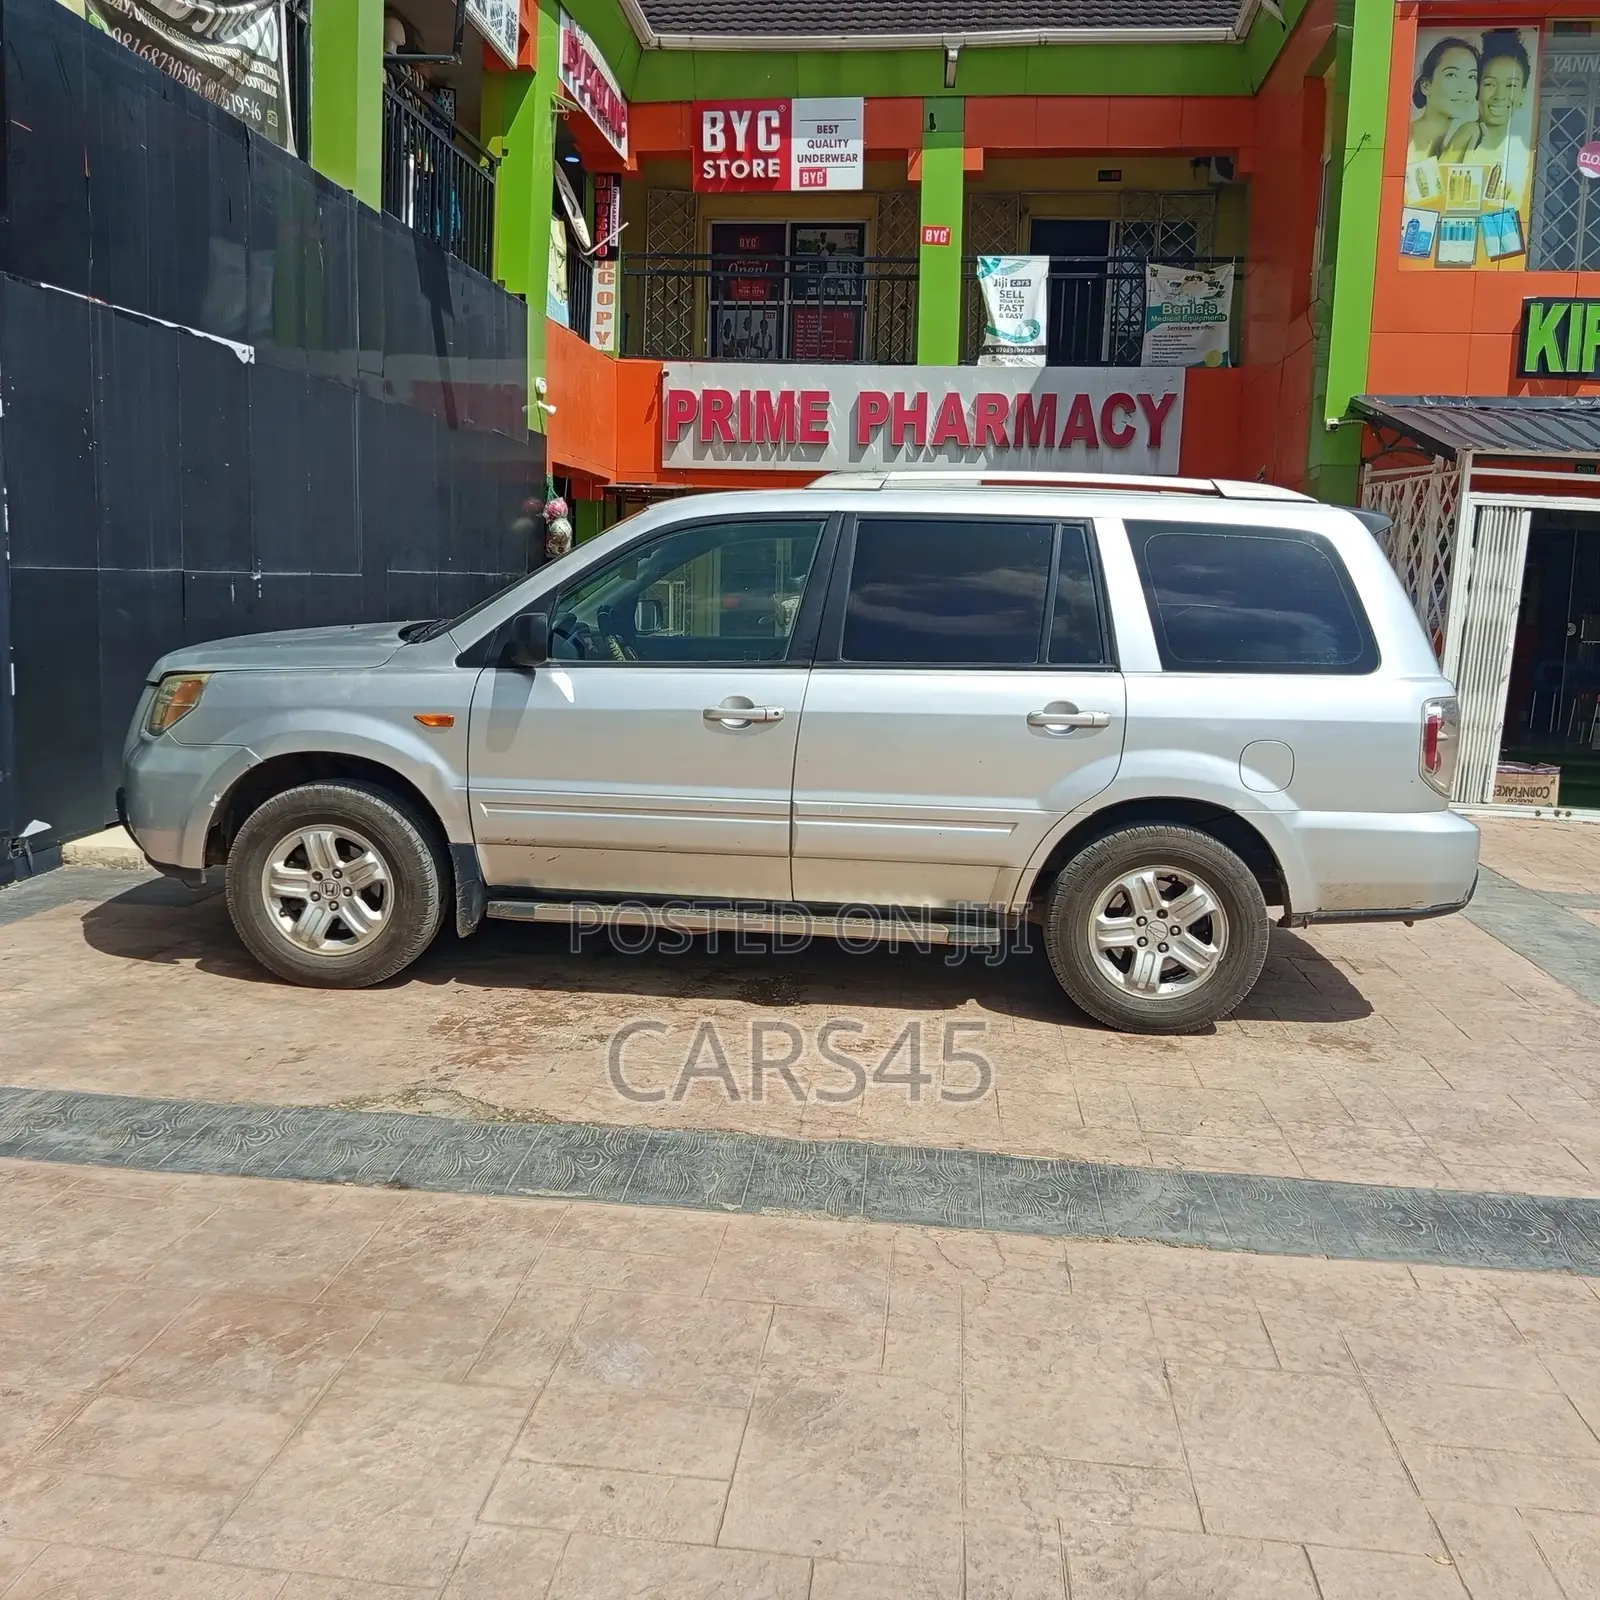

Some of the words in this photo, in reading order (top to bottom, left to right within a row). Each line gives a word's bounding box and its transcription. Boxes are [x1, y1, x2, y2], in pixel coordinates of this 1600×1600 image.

[1554, 56, 1600, 72] YANN
[703, 110, 780, 152] BYC
[816, 124, 840, 134] BEST
[807, 139, 850, 149] QUALITY
[797, 154, 858, 164] UNDERWEAR
[1580, 152, 1600, 166] CLO
[703, 159, 780, 179] STORE
[802, 172, 824, 184] BYC
[925, 230, 947, 242] BYC
[740, 238, 757, 247] BYC
[999, 290, 1024, 299] SELL
[1182, 314, 1226, 322] Equipments
[666, 389, 830, 444] PRIME
[856, 392, 1178, 448] PHARMACY
